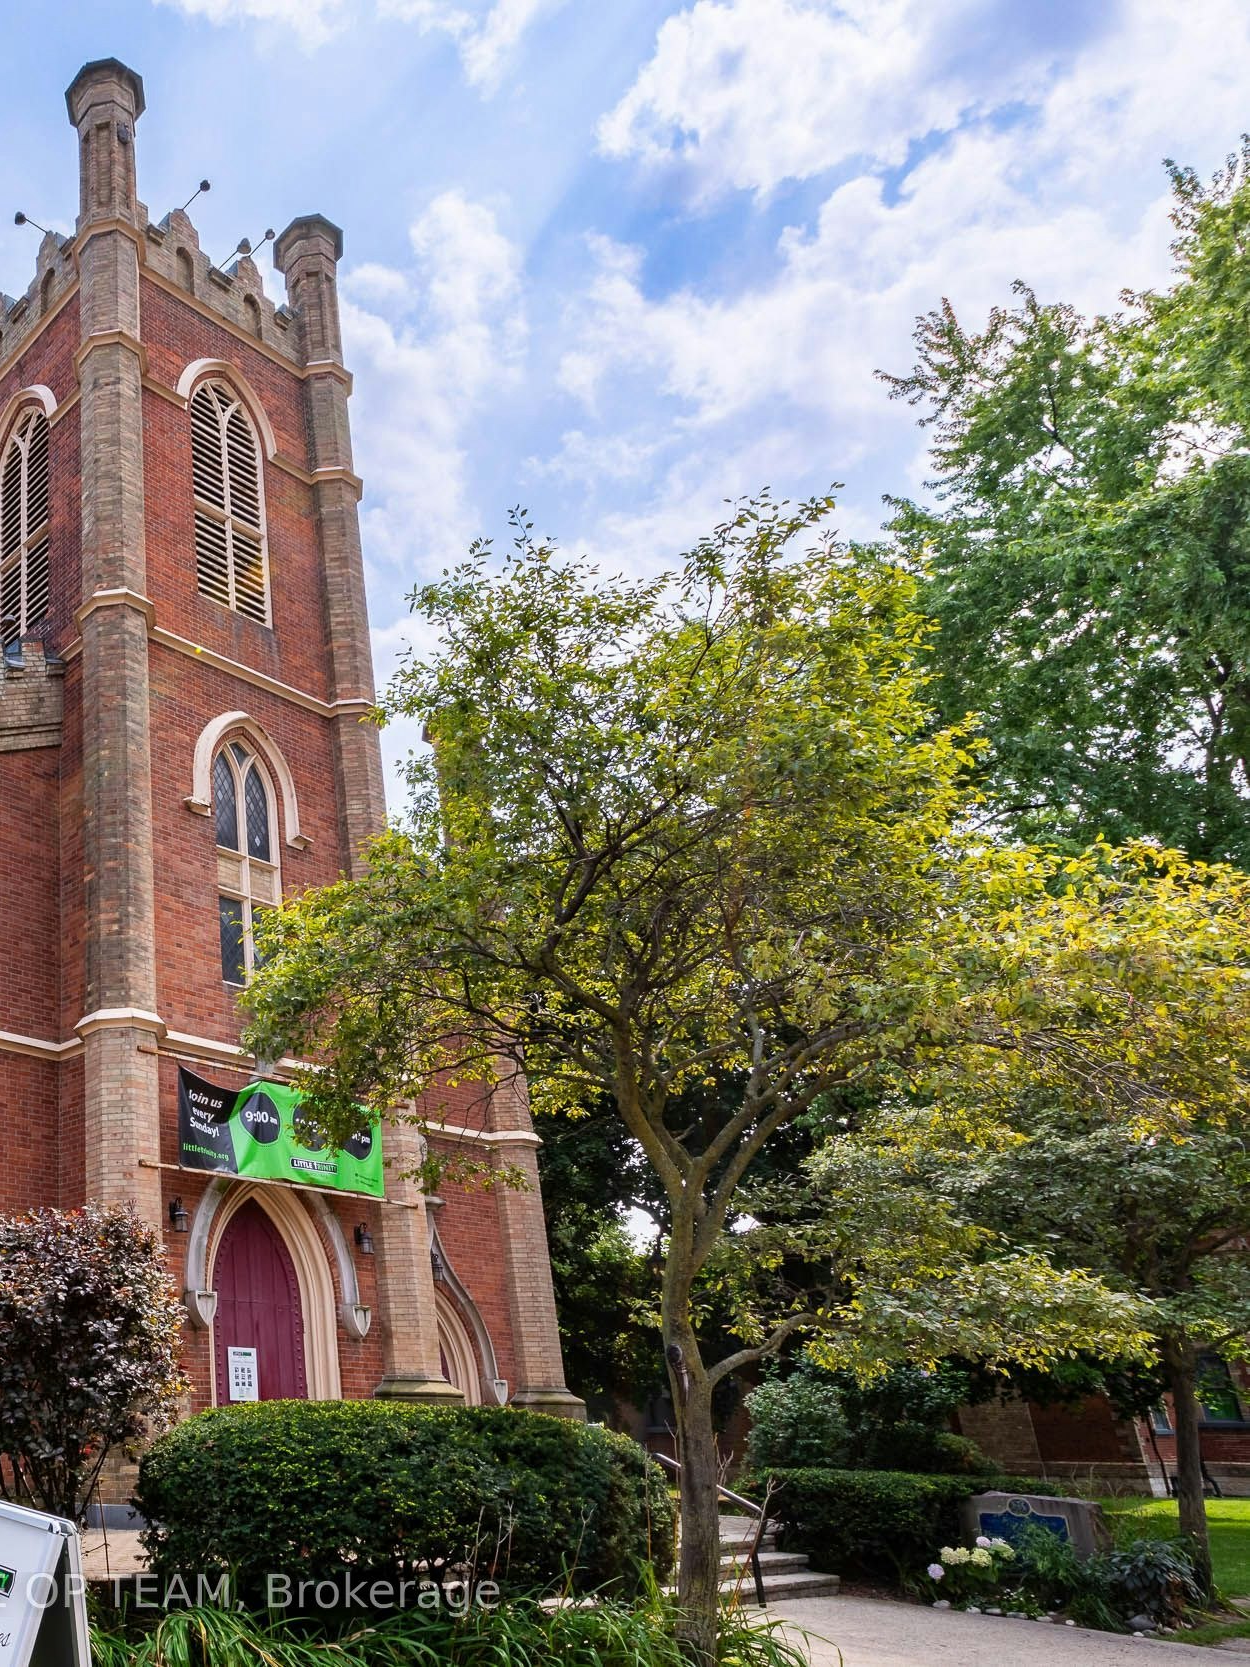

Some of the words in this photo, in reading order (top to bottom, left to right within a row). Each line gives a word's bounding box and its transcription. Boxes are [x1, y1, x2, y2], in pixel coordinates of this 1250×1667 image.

[188, 1089, 209, 1105] Join
[210, 1098, 223, 1109] us
[192, 1106, 215, 1123] every
[244, 1110, 269, 1123] 9:00
[189, 1116, 220, 1138] Sunday!
[293, 1159, 313, 1169] LITTLE
